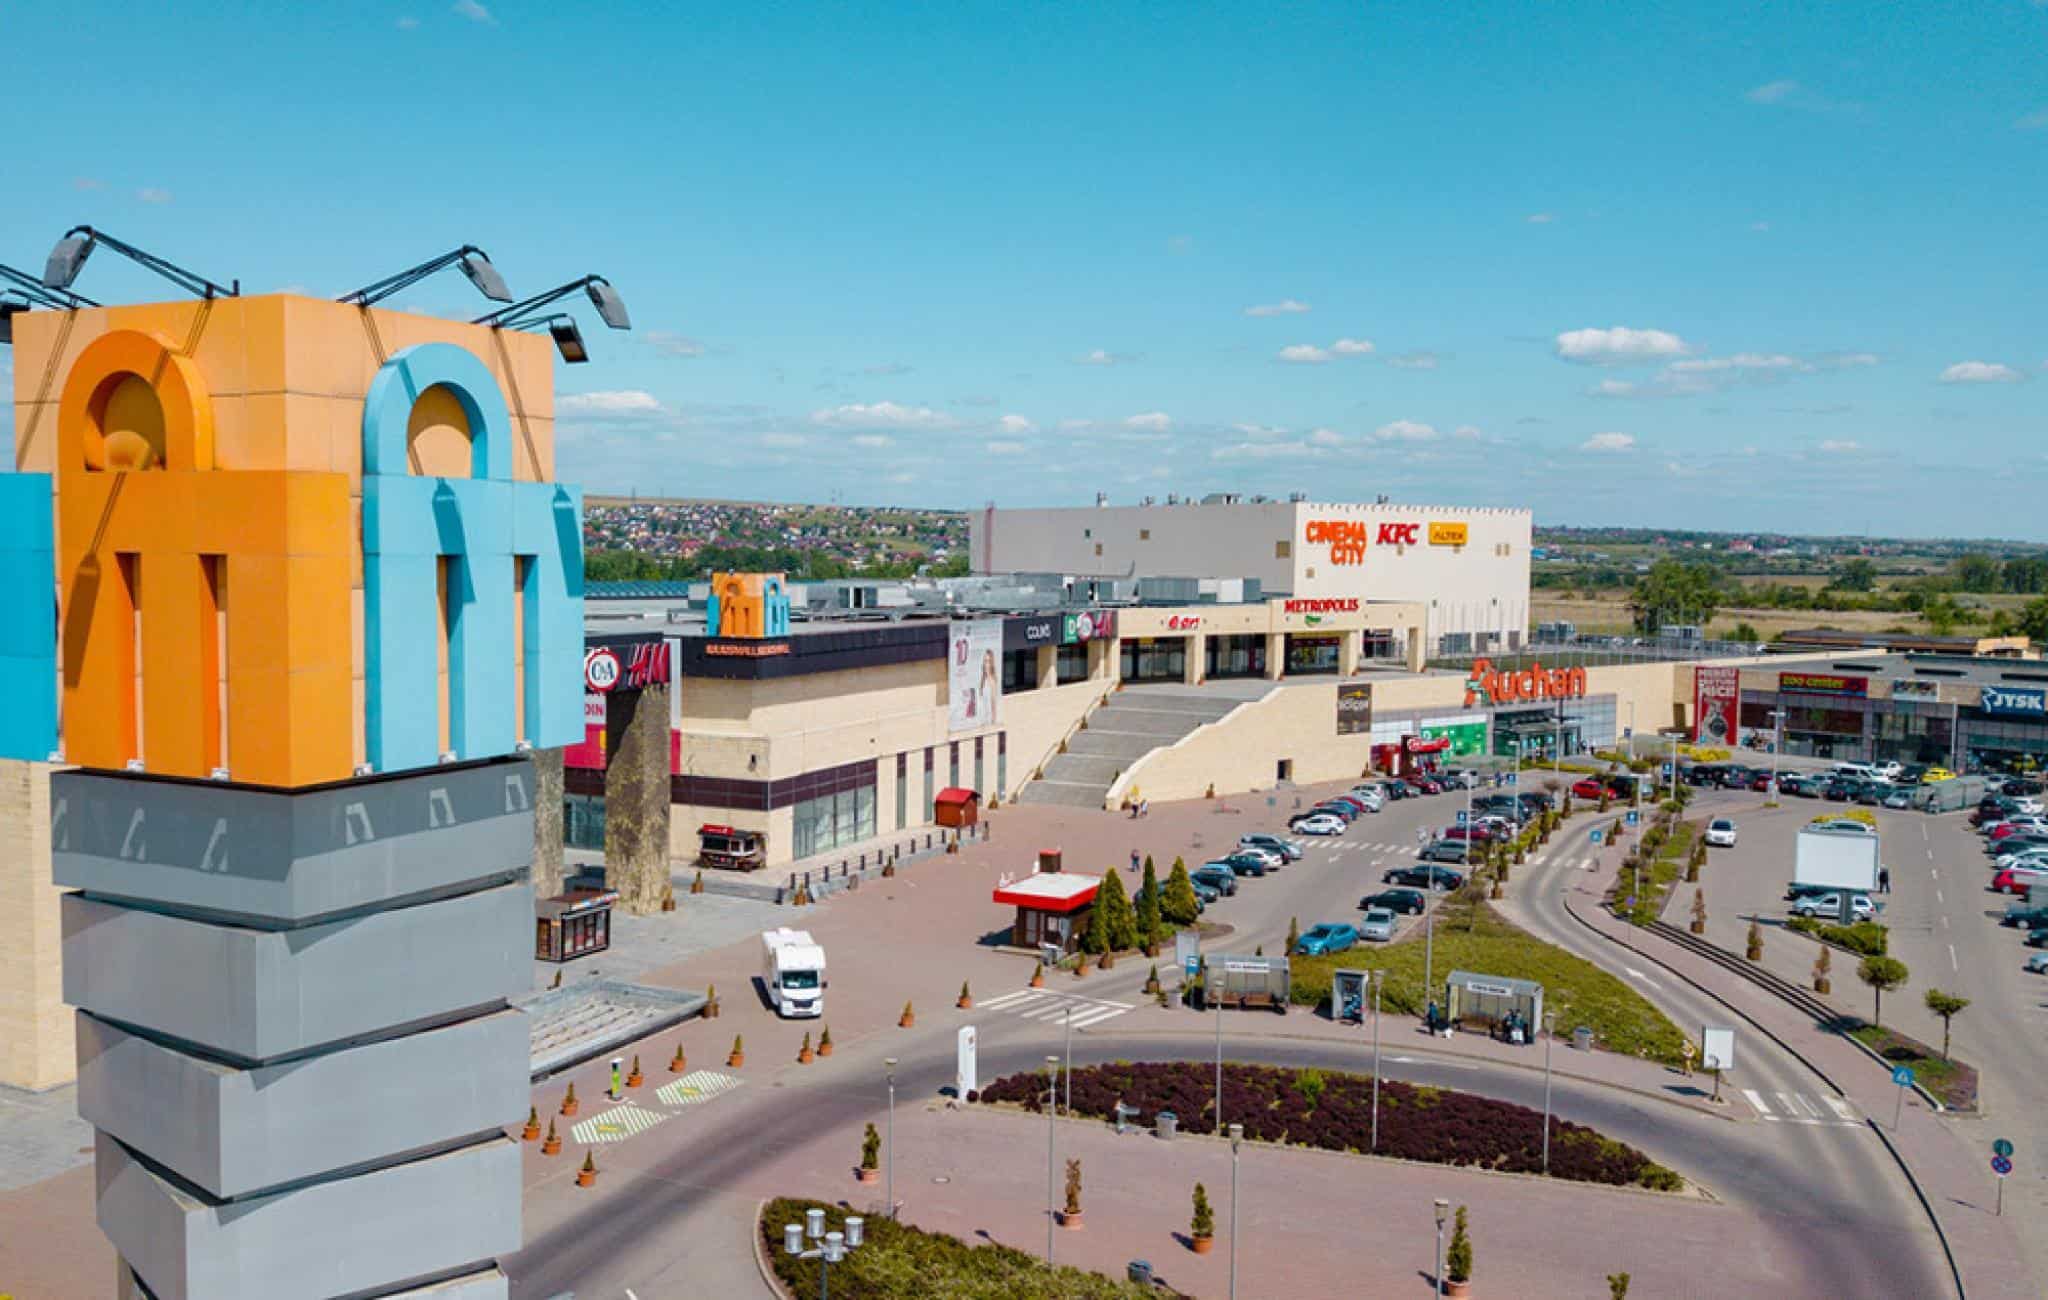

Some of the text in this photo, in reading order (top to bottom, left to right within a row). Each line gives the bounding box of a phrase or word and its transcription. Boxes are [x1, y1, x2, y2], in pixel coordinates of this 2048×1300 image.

[1306, 520, 1366, 544] CINEMA
[1376, 523, 1420, 545] KFC
[1331, 543, 1365, 565] CITY
[1284, 598, 1359, 613] METROPOLIS
[1463, 657, 1587, 707] Auchan
[1992, 694, 2043, 710] JYSK
